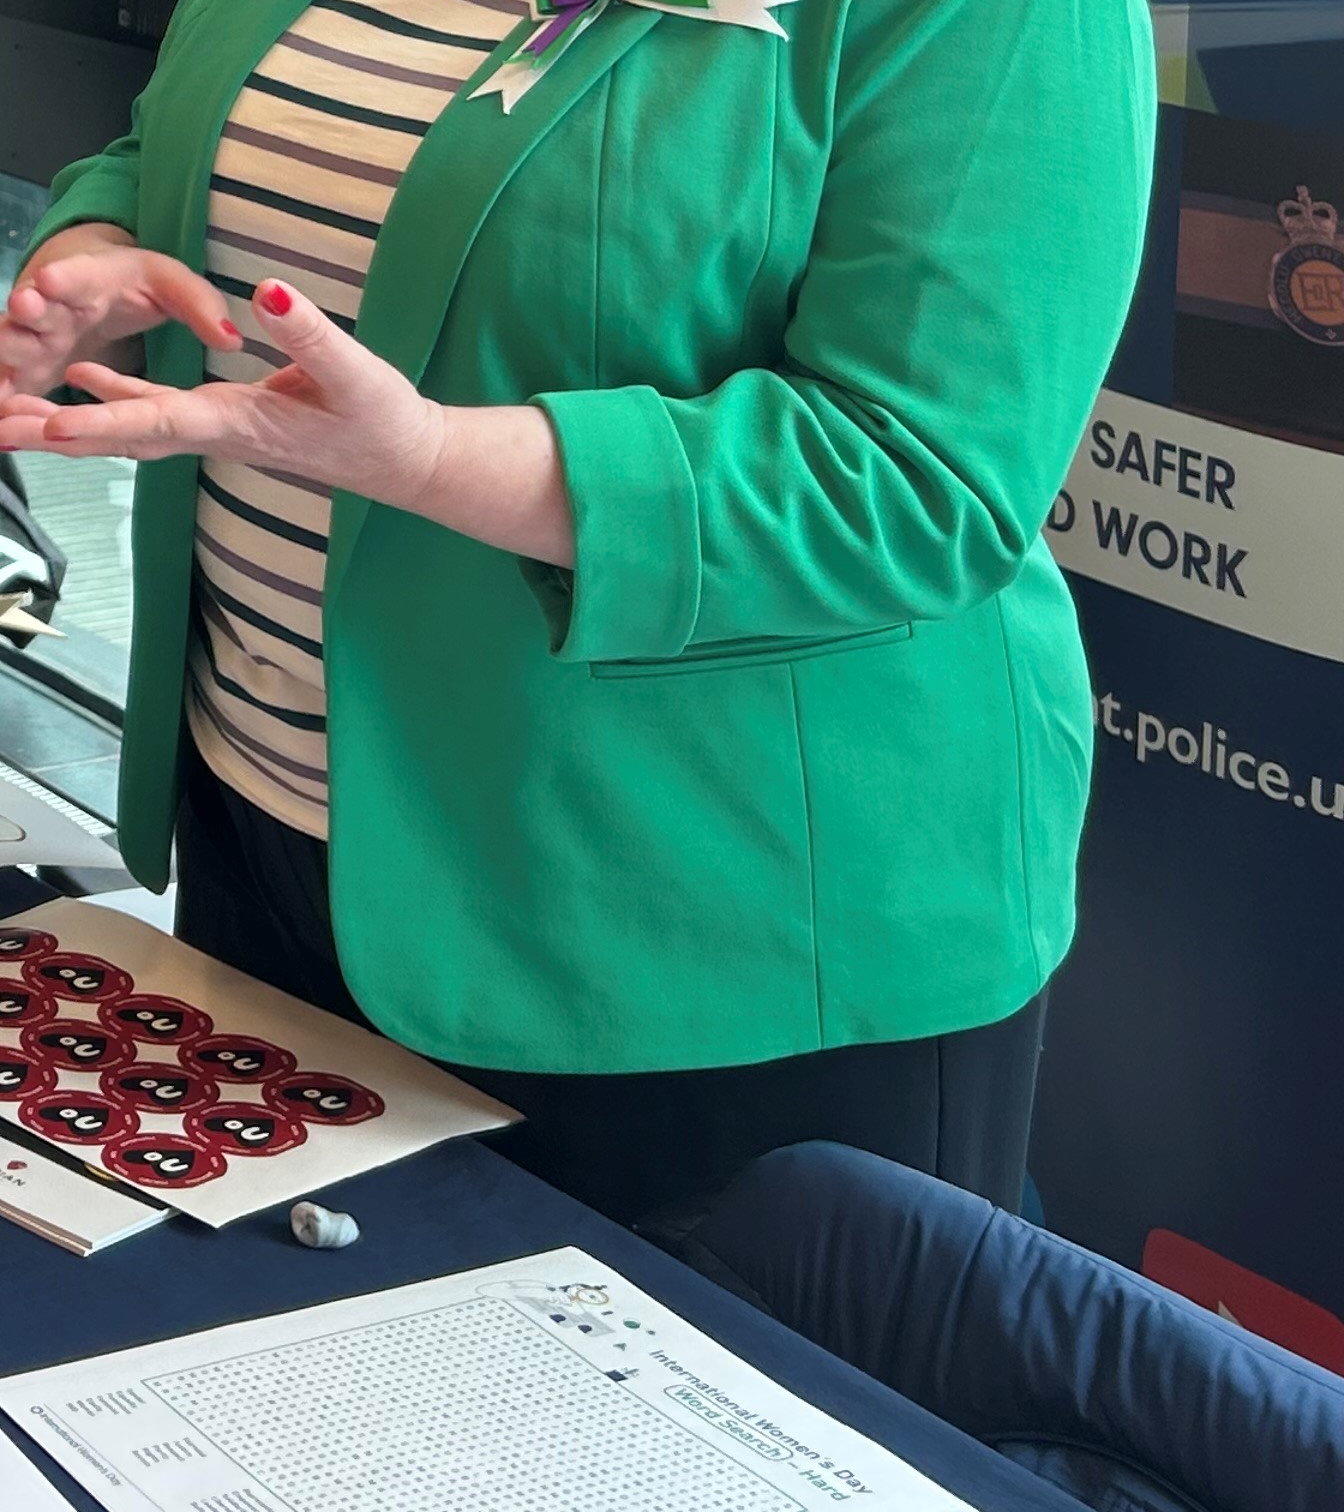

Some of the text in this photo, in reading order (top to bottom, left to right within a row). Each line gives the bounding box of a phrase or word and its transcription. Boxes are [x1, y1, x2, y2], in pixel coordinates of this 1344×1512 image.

[1091, 418, 1237, 511] SAFER
[1092, 500, 1249, 599] WORK
[649, 1349, 874, 1495] International Women's Day
[674, 1388, 722, 1419] Word
[718, 1419, 783, 1458] Search
[798, 1469, 852, 1501] Hard
